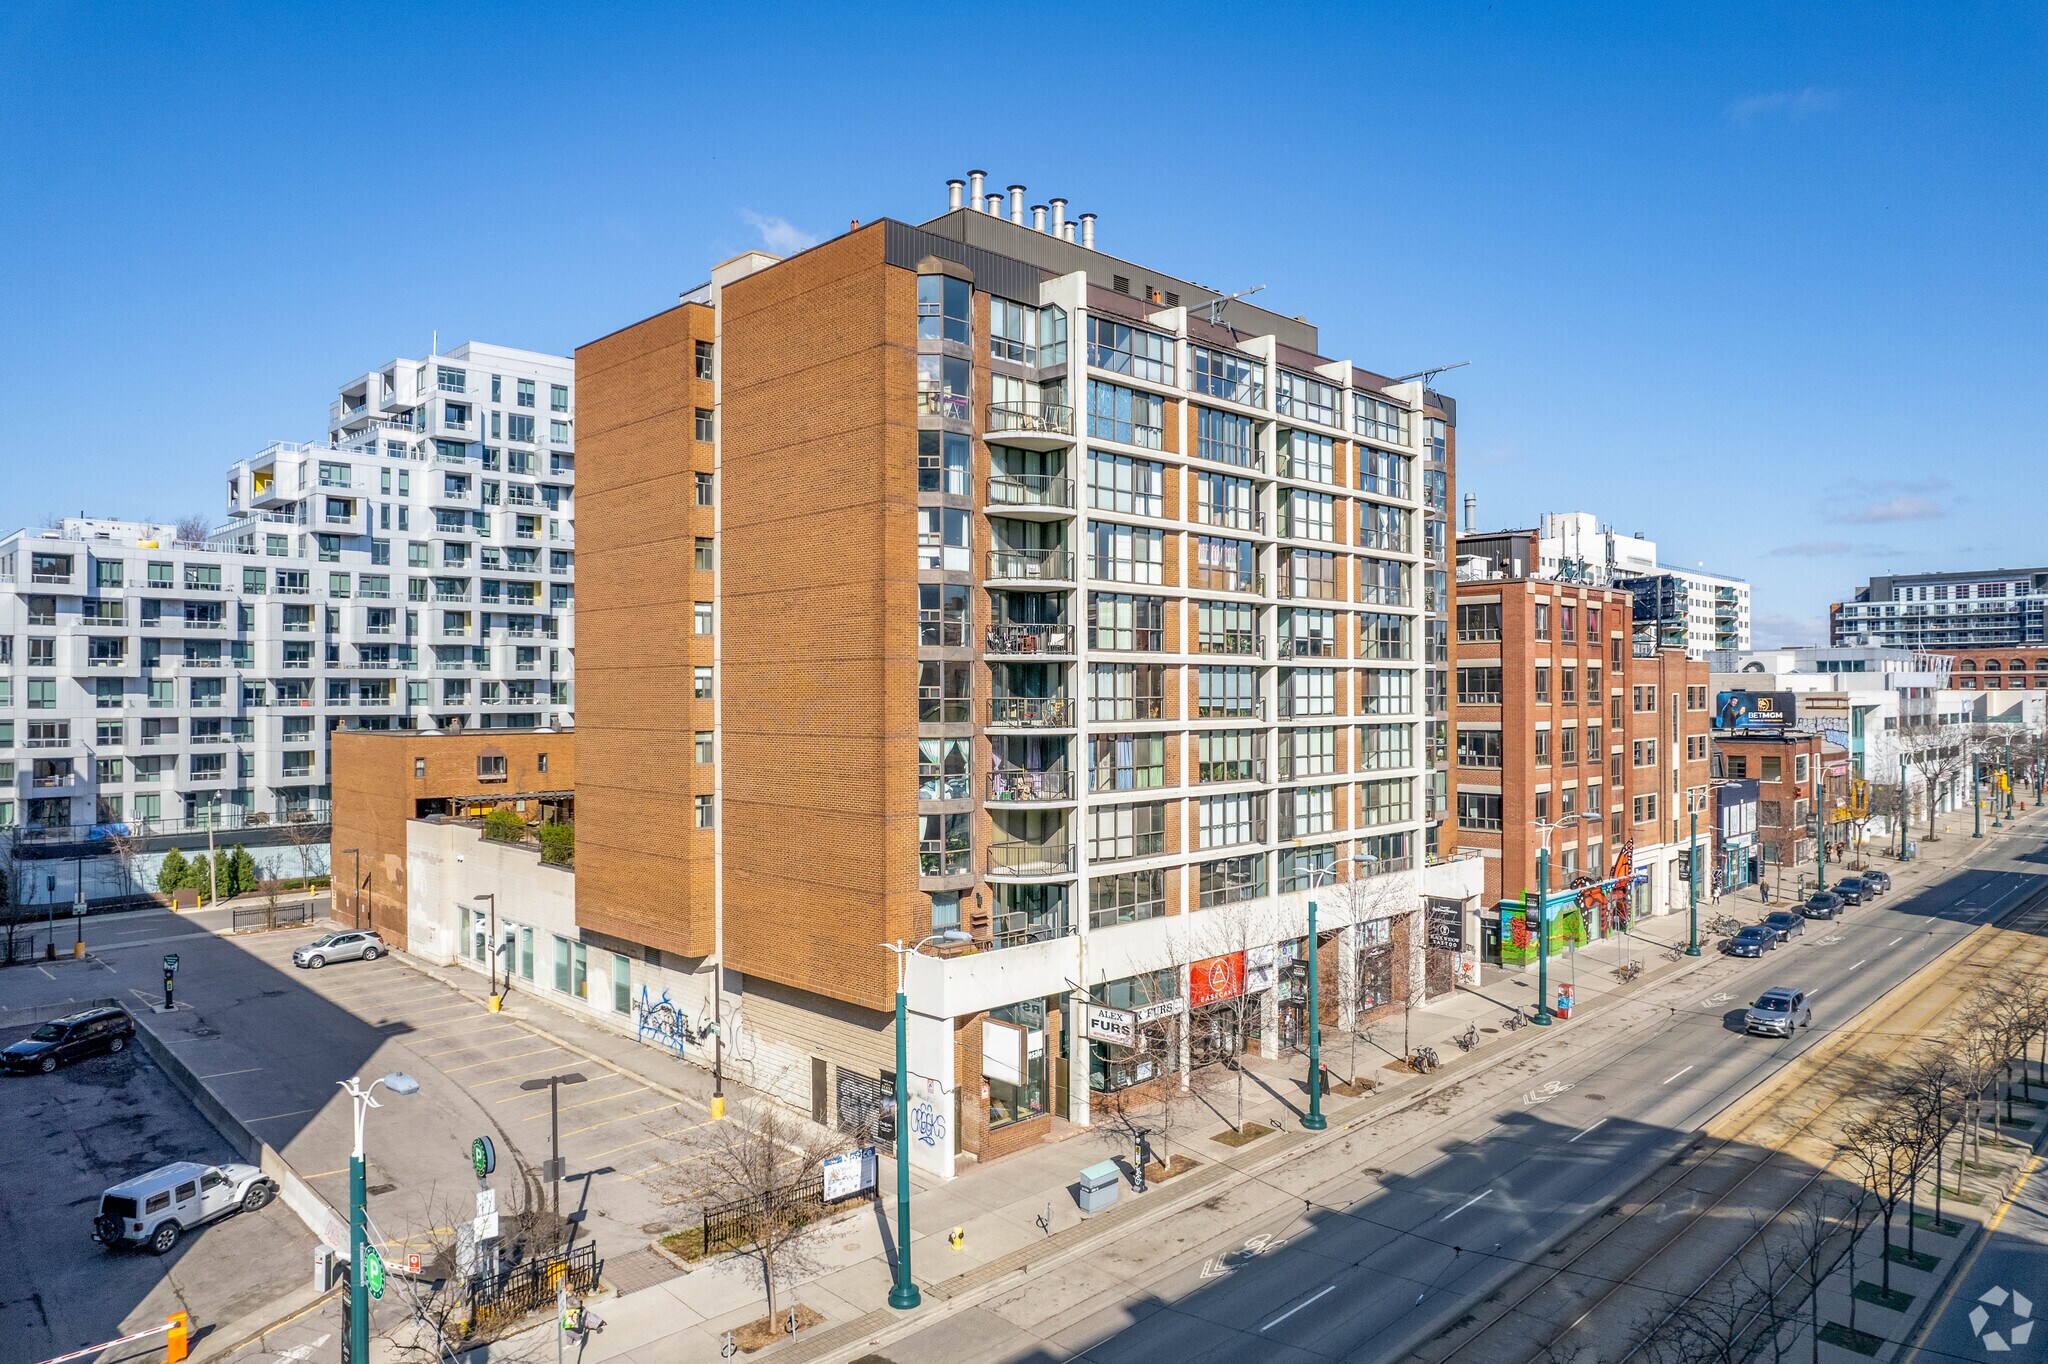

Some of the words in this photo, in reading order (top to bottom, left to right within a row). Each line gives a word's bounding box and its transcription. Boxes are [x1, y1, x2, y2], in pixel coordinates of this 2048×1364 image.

[1432, 939, 1458, 948] TATTOO
[1098, 1009, 1124, 1022] ALEX
[1147, 1002, 1173, 1018] FURS
[1091, 1018, 1132, 1037] FURS
[475, 1147, 482, 1162] P
[369, 1258, 379, 1279] P
